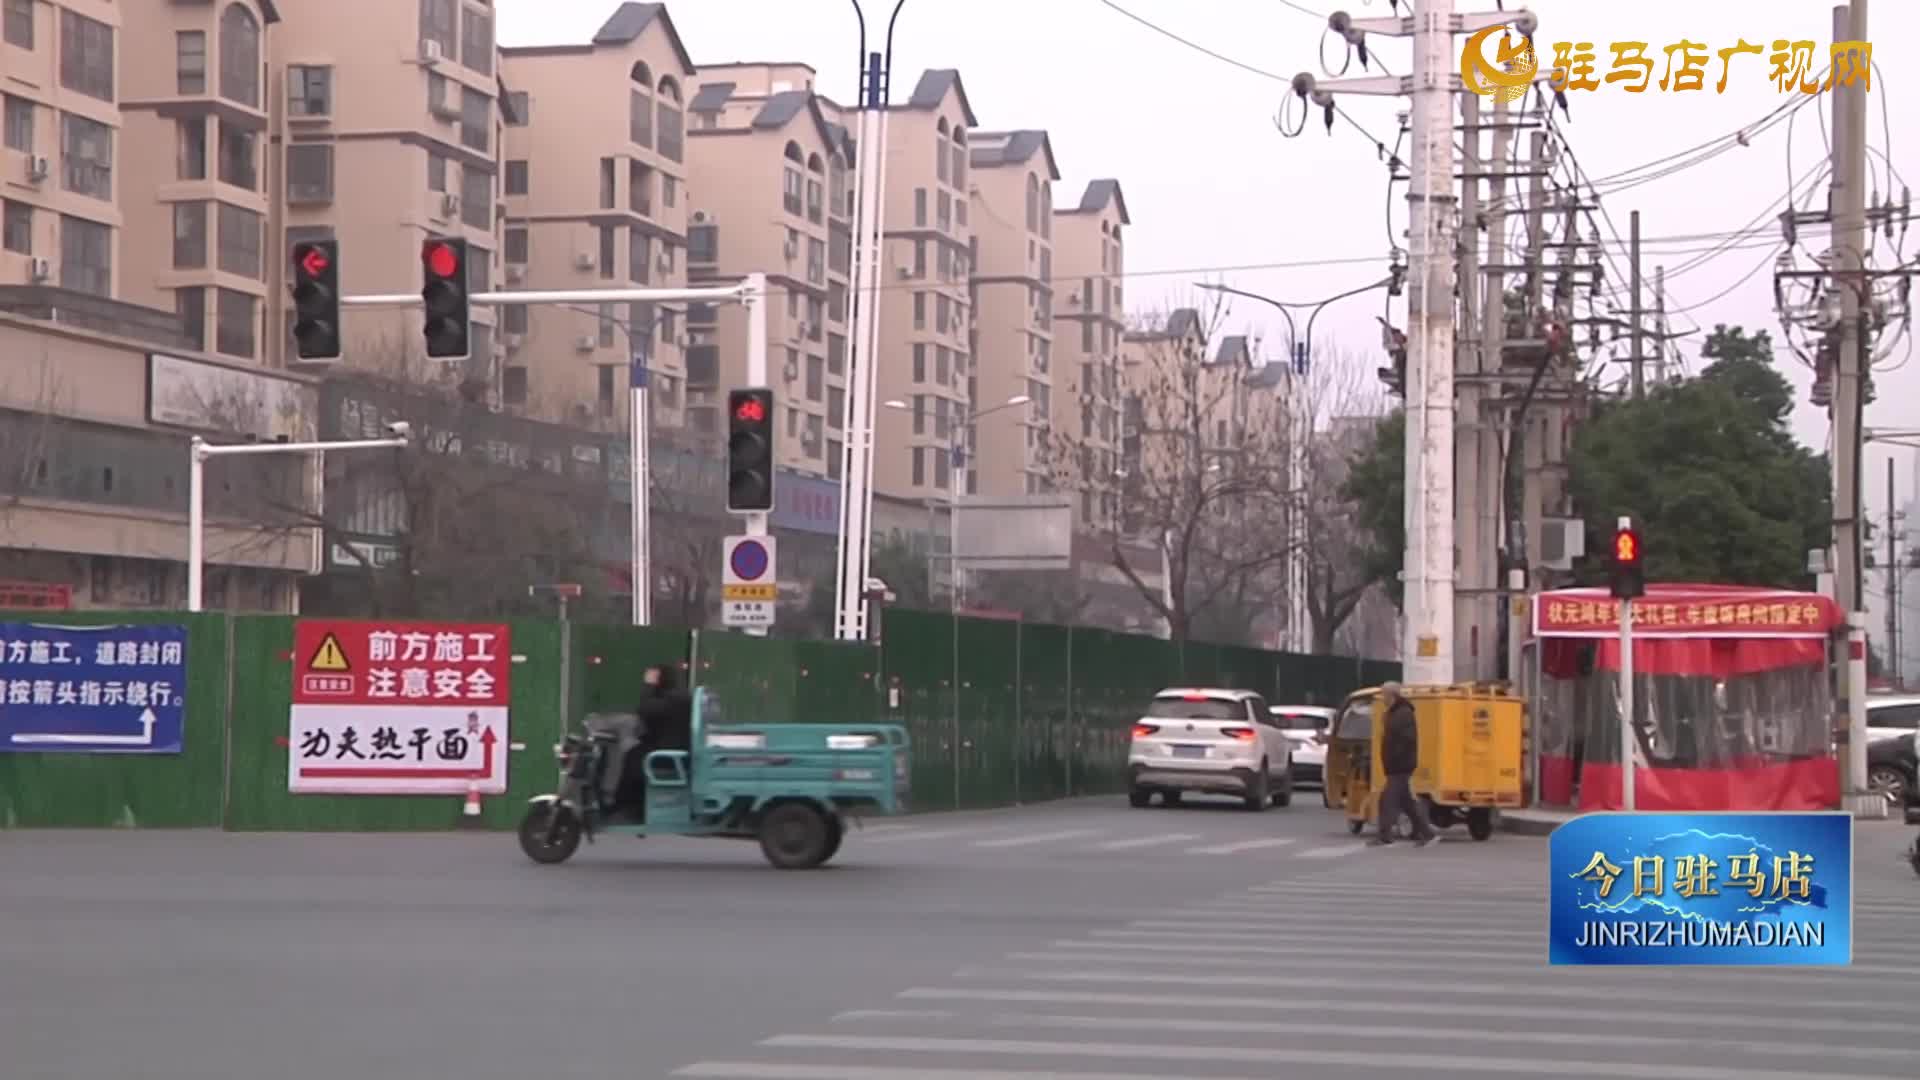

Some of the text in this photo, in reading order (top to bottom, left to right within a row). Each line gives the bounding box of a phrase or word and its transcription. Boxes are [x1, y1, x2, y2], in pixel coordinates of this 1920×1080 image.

[367, 630, 496, 662] 前方施工
[367, 667, 496, 698] 注意安全
[300, 726, 469, 762] 功夫热干面
